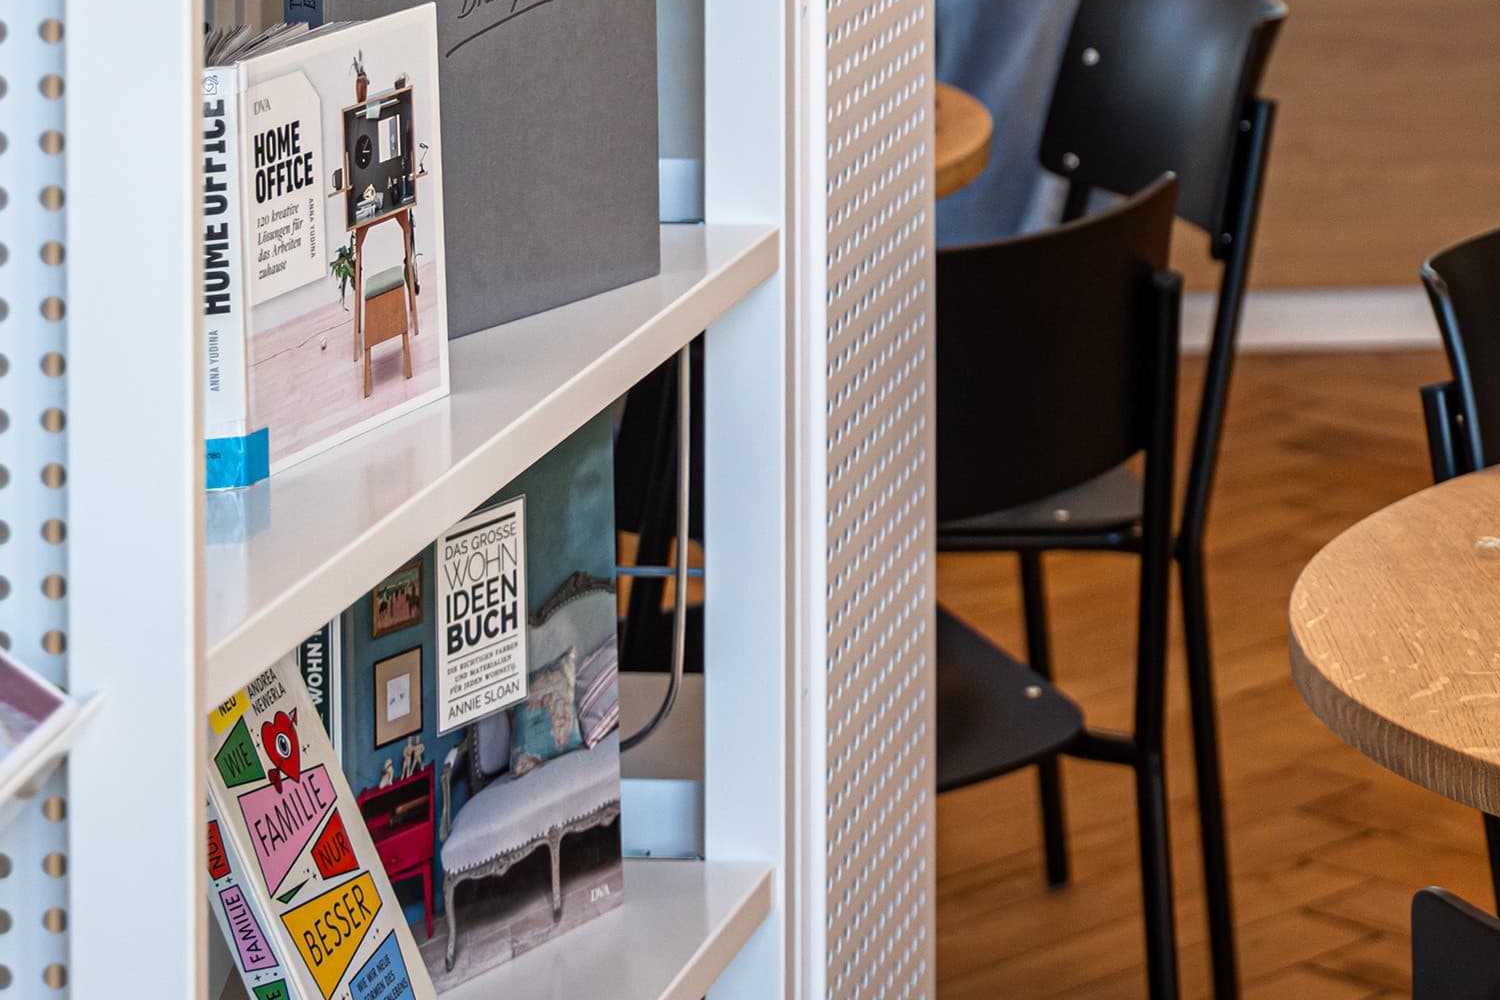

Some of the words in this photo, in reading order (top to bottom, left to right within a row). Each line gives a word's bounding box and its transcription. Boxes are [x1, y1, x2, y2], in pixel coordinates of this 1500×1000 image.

[253, 98, 271, 116] DVA
[203, 98, 228, 216] OFFICE
[254, 119, 301, 169] HOME
[255, 151, 314, 204] OFFICE
[257, 214, 270, 229] 120
[271, 203, 300, 224] kreative
[258, 223, 291, 246] Lösungen
[292, 218, 304, 240] für
[203, 222, 231, 315] HOME
[258, 247, 270, 262] das
[271, 236, 302, 258] Arbeiten
[258, 258, 287, 280] zuhause
[208, 329, 220, 364] YUDINA
[210, 366, 220, 392] ANNA
[445, 539, 468, 562] DAS
[471, 521, 517, 551] GROSSE
[444, 537, 518, 590] WOHN
[446, 568, 518, 625] IDEEN
[446, 601, 518, 656] BUCH
[247, 669, 278, 700] ANDREA
[251, 682, 287, 717] NEWERLA
[448, 693, 482, 720] ANNIE
[485, 679, 520, 706] SLOAN
[224, 742, 252, 779] WIE
[253, 773, 328, 857] FAMILIE
[317, 831, 350, 871] NUR
[226, 893, 265, 964] FAMILIE
[303, 884, 372, 967] BESSER
